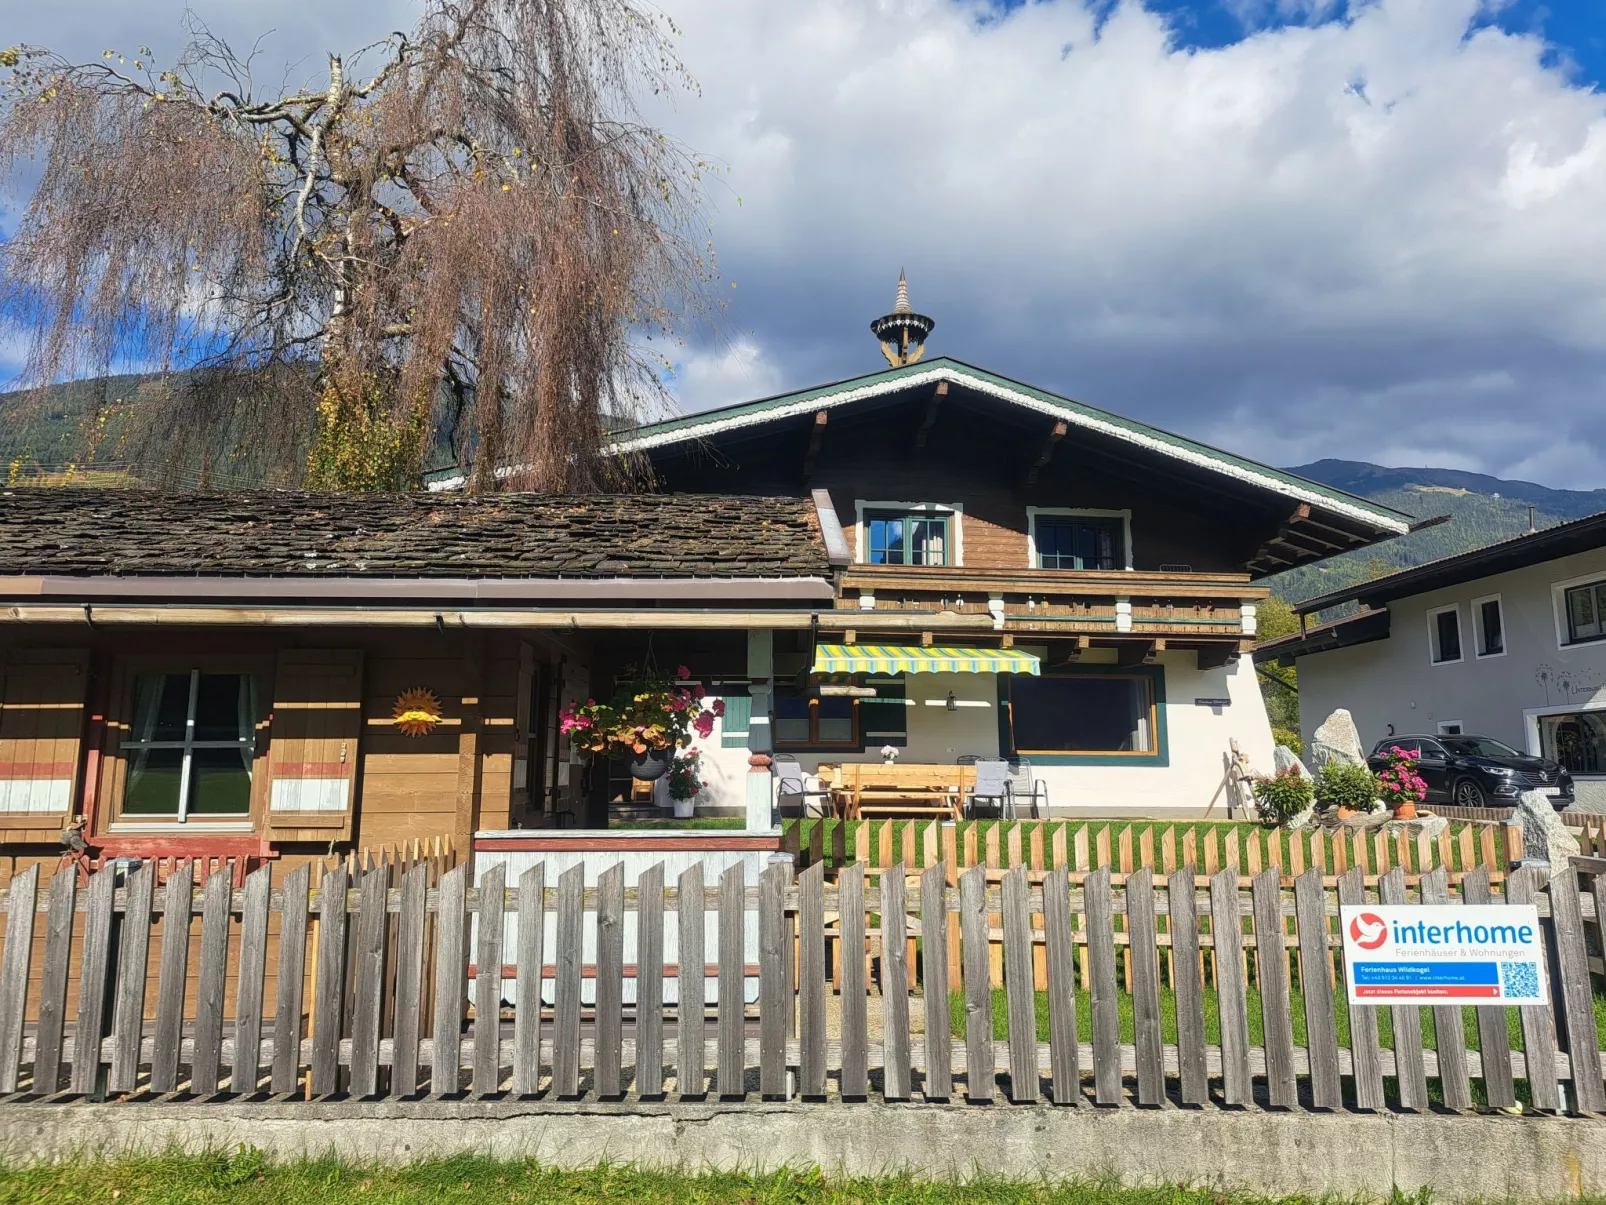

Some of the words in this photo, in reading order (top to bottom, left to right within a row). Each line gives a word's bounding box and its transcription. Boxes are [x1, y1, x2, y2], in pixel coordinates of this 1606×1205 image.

[1392, 920, 1533, 944] interhome
[1396, 948, 1457, 957] Ferienhäuser
[1460, 949, 1467, 957] &
[1469, 948, 1525, 959] Wohnungen
[1397, 966, 1430, 975] Wildkogel
